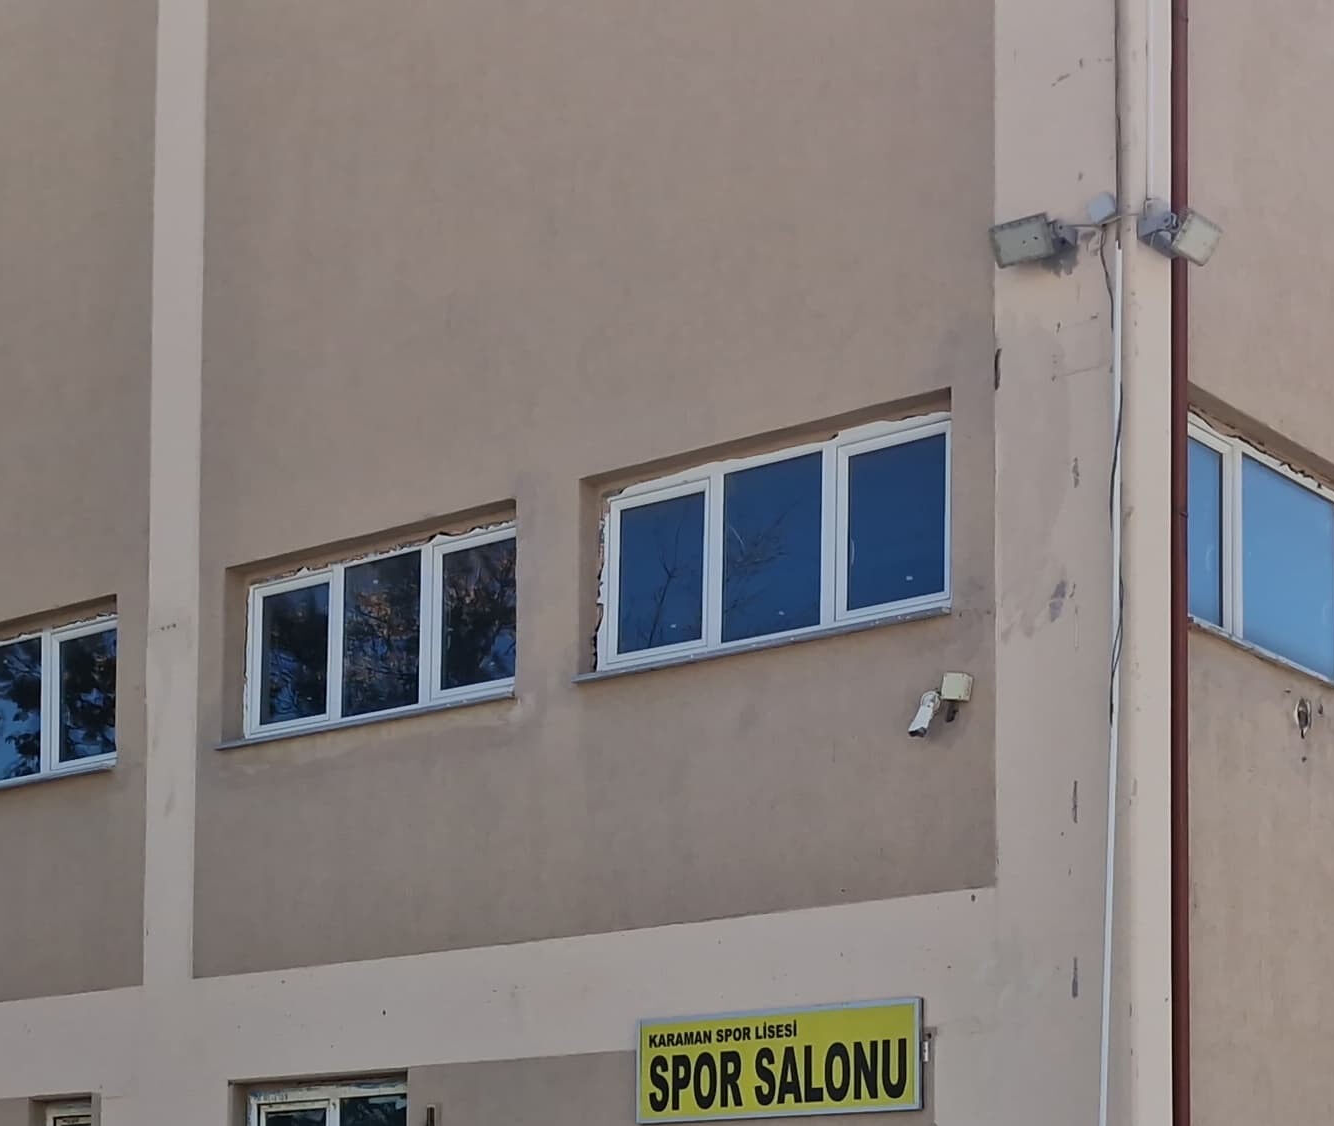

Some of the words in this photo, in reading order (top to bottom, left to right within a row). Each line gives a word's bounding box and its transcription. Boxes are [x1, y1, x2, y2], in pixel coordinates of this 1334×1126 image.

[649, 1030, 711, 1048] KARAMAN
[716, 1026, 751, 1042] SPOR
[755, 1020, 797, 1039] LİSESİ
[649, 1050, 743, 1112] SPOR
[754, 1038, 907, 1106] SALONU
